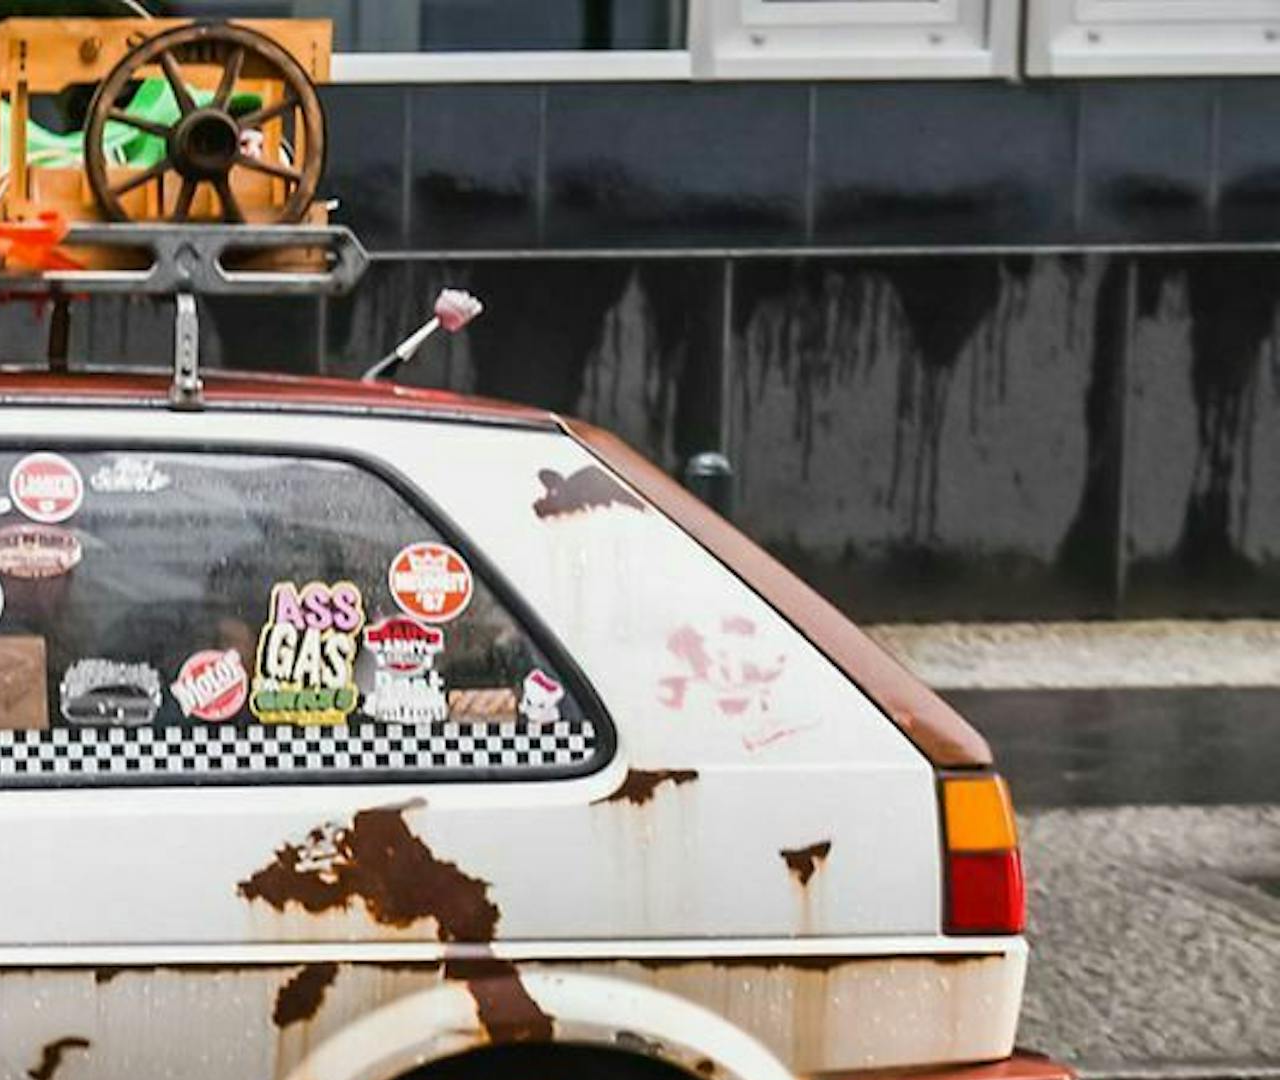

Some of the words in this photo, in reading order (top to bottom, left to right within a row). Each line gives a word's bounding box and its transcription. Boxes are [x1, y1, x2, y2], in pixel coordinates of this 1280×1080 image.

[276, 583, 360, 631] ASS
[172, 649, 241, 717] Motor
[265, 623, 351, 690] GAS
